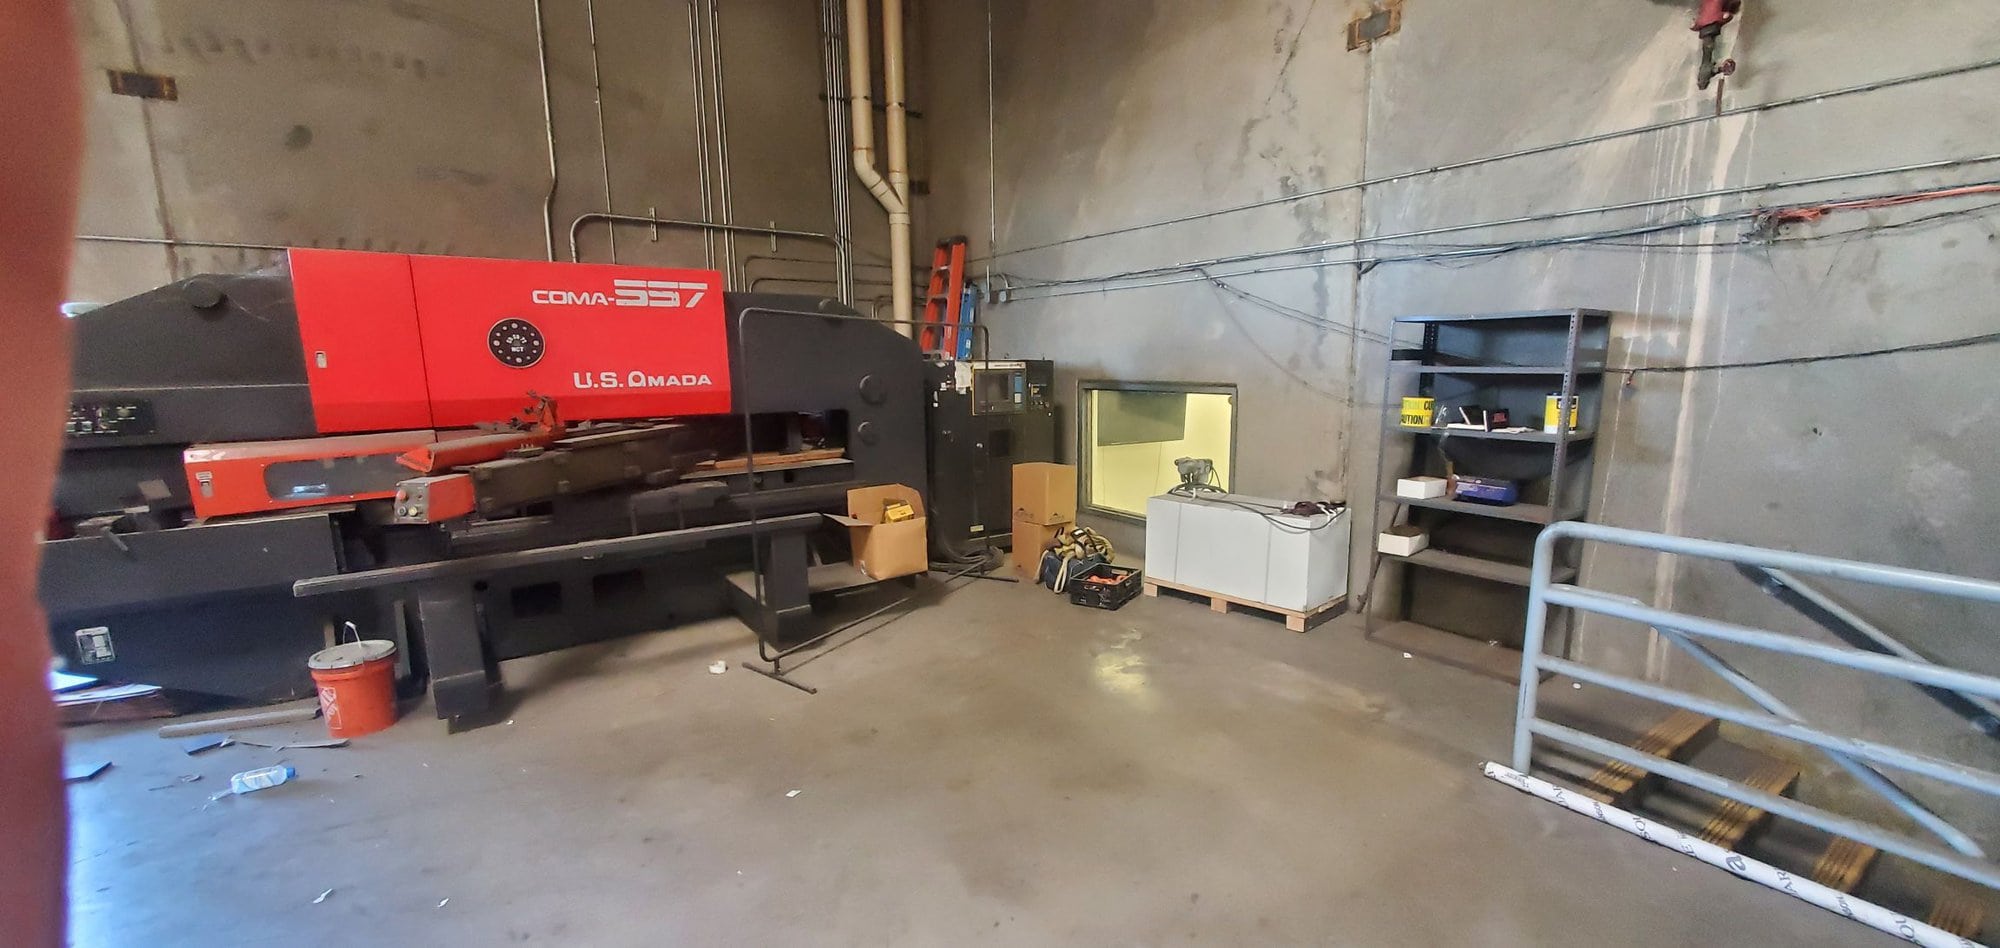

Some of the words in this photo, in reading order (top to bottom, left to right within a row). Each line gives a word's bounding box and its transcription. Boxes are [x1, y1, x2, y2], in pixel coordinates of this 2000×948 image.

[532, 279, 708, 308] COMA-557
[573, 371, 624, 389] U.S.
[627, 370, 713, 388] AMADA
